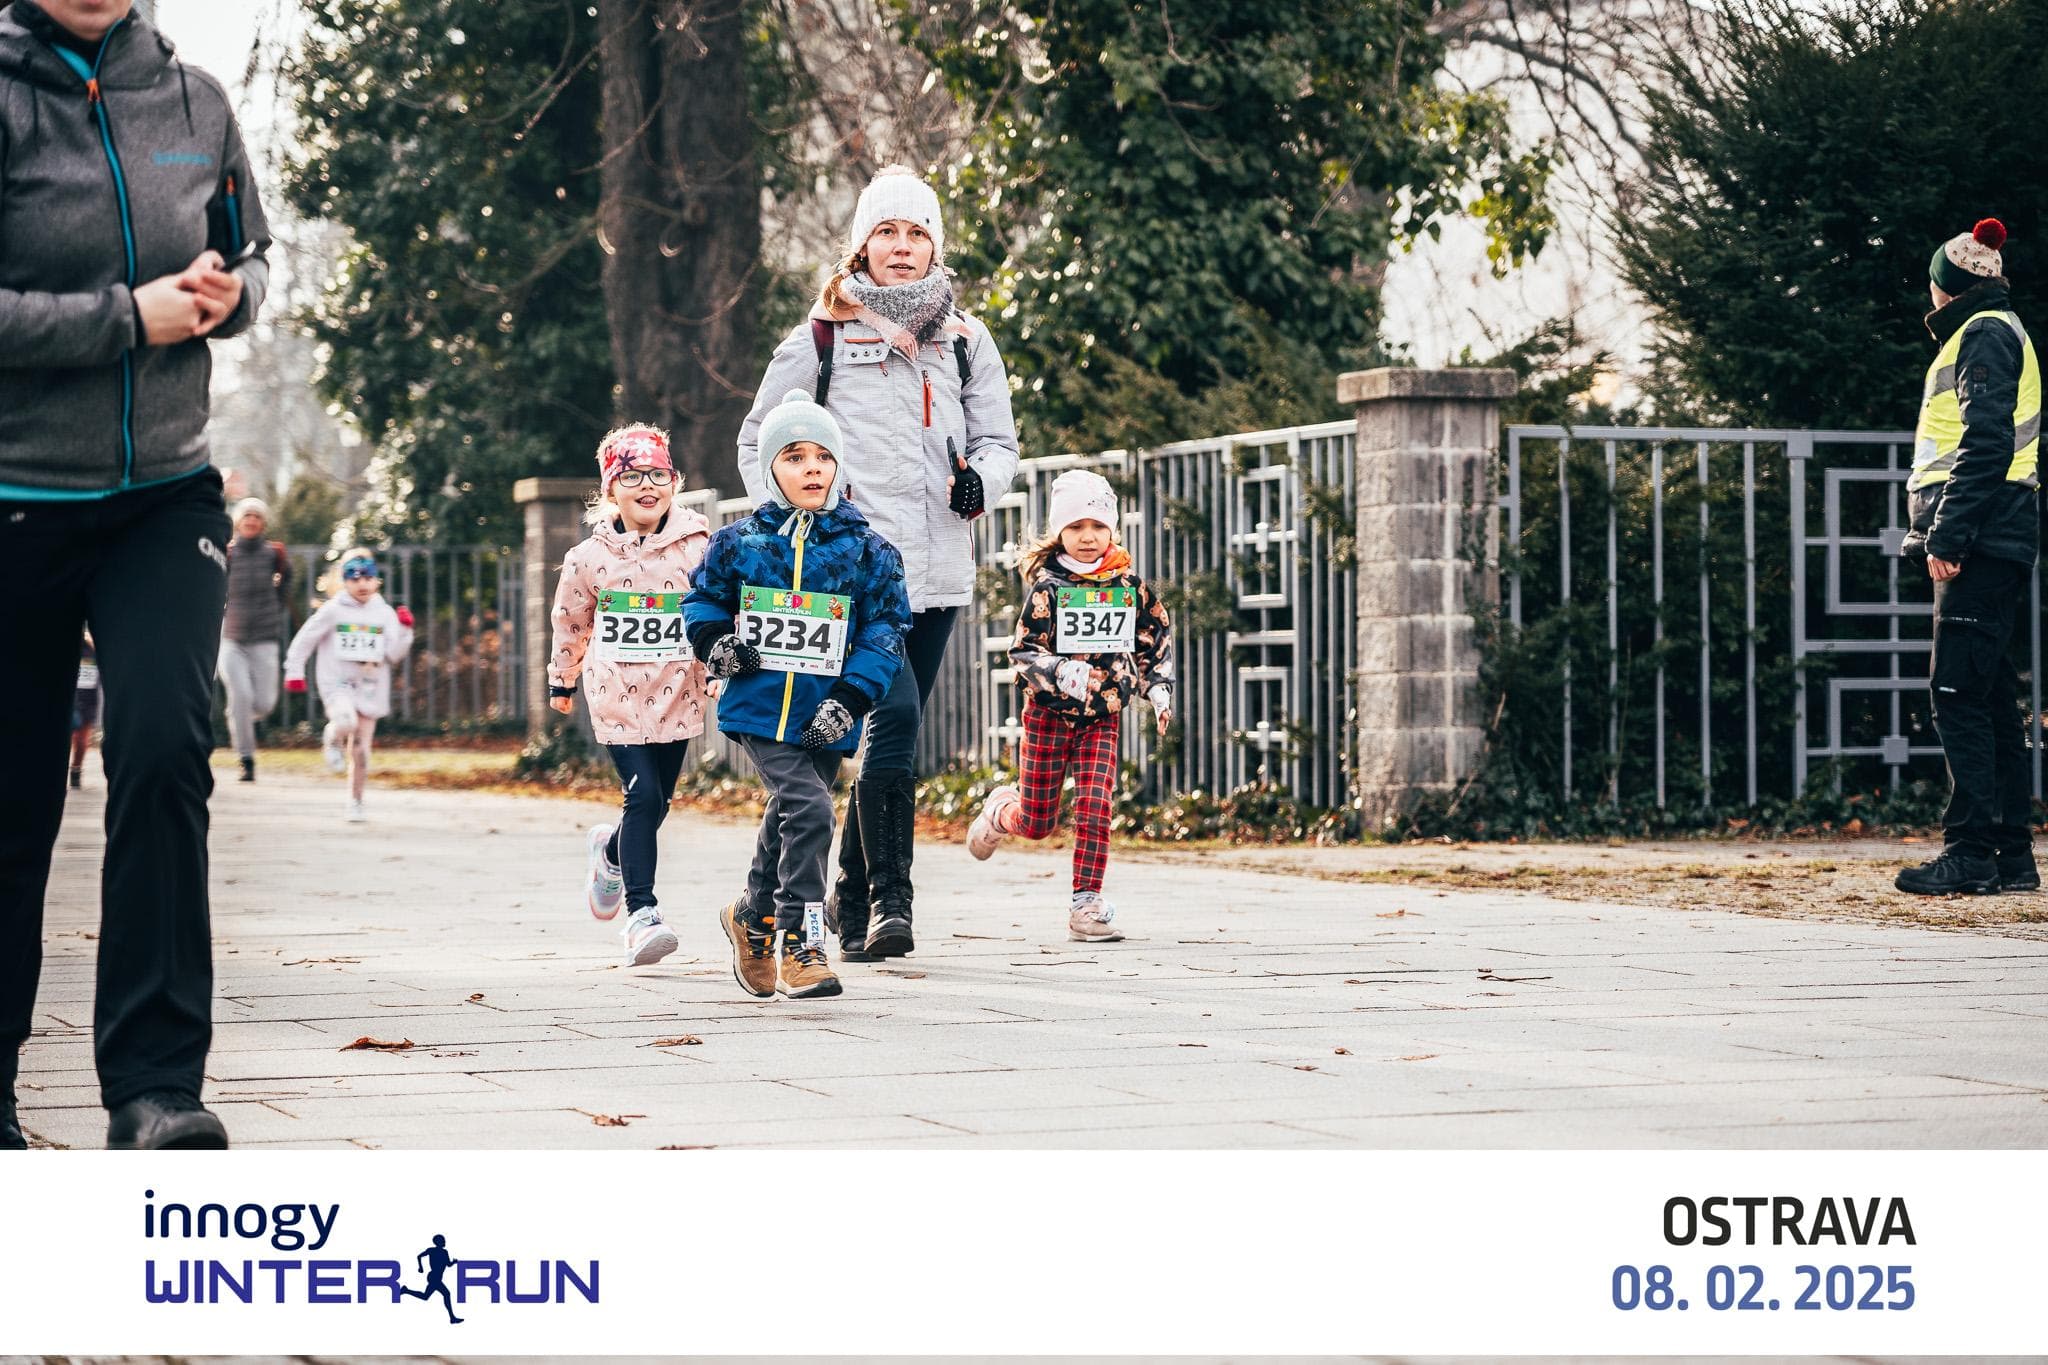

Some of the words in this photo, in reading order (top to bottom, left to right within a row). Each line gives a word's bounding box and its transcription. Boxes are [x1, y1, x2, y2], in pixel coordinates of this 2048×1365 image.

[601, 616, 683, 644] 3284
[745, 615, 831, 654] 3234
[1064, 612, 1126, 637] 3347
[810, 913, 819, 938] 3234
